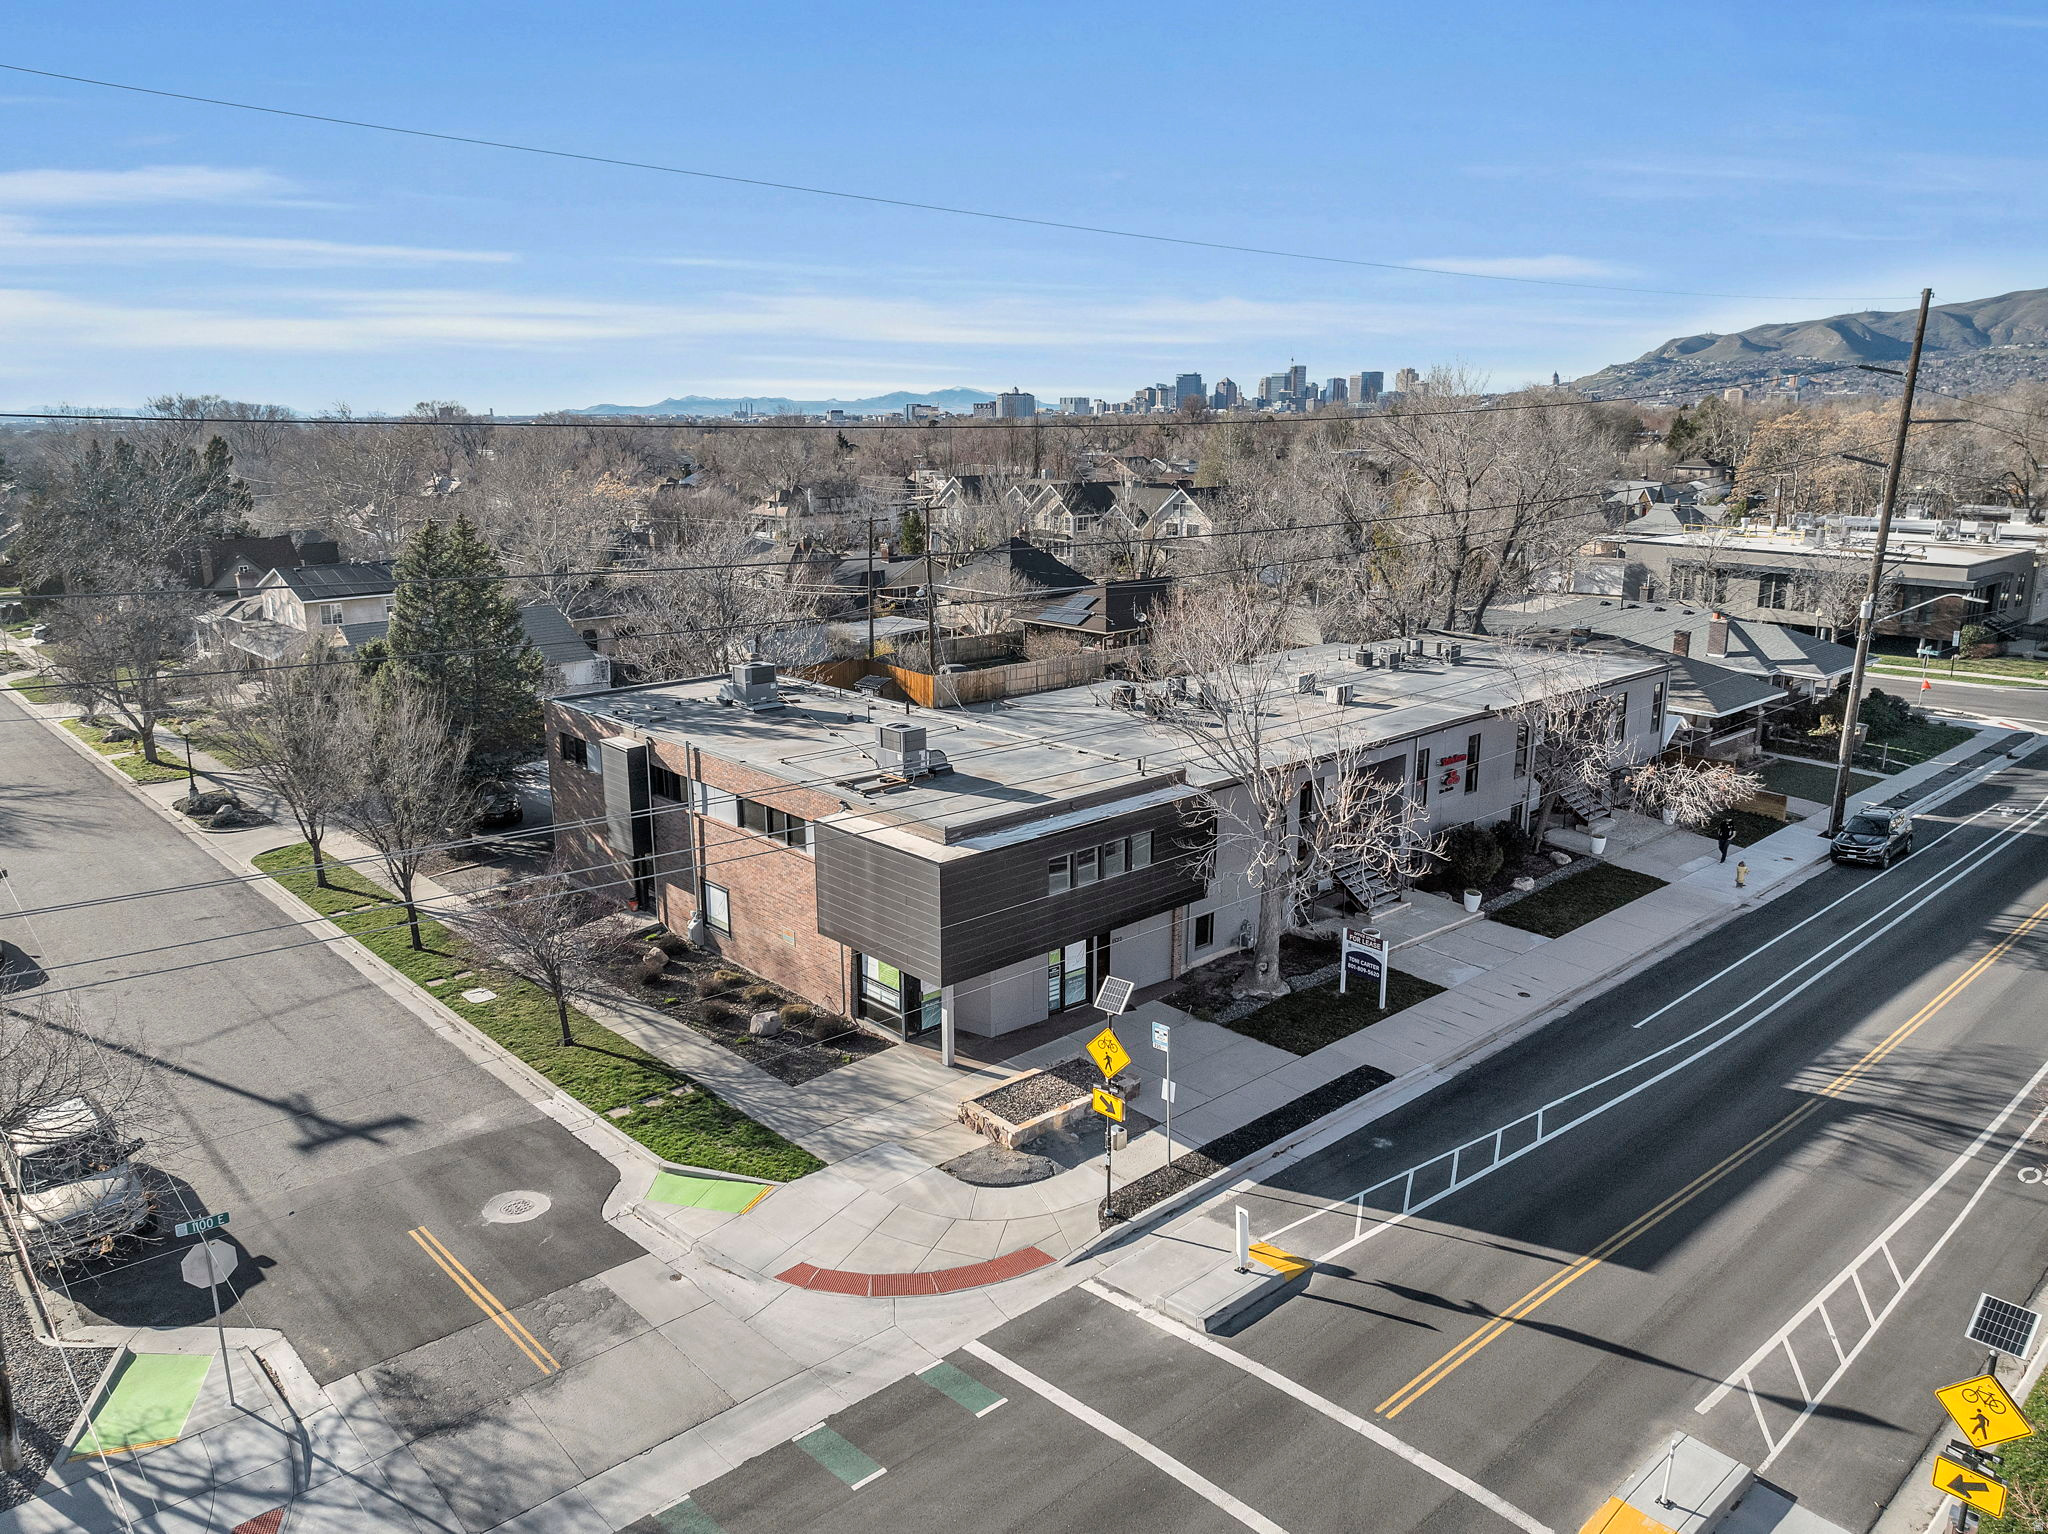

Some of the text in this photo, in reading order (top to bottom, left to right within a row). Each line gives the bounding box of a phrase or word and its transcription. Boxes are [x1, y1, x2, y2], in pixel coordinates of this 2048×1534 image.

[1349, 934, 1381, 950] FOR LEASE
[1353, 931, 1365, 939] OFFICE
[1347, 962, 1380, 978] 801-809-5620
[1360, 960, 1380, 971] CARTER
[192, 1218, 214, 1232] 1100
[217, 1214, 225, 1225] E
